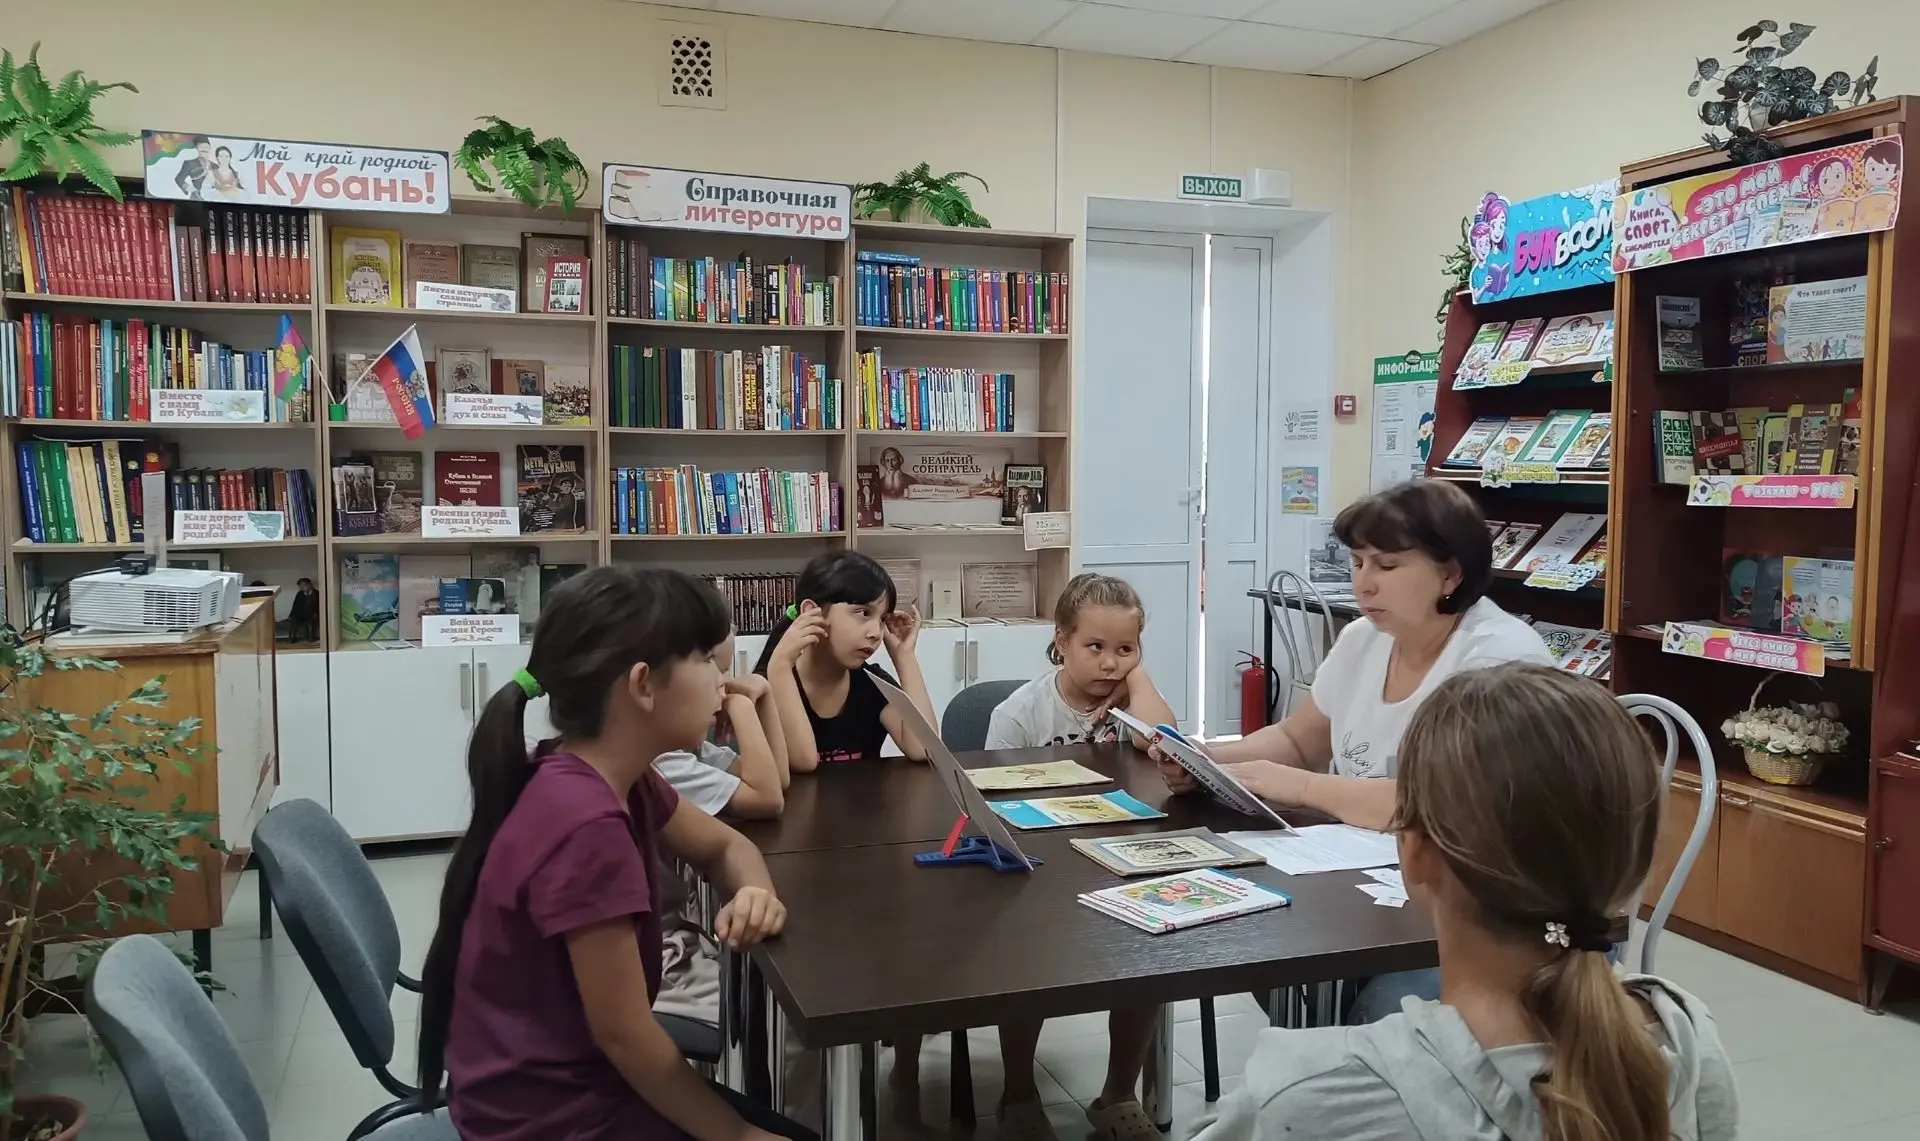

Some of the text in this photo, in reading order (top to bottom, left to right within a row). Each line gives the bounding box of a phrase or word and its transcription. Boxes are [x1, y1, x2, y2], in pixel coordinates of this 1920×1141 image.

[239, 142, 292, 162] Мой
[304, 151, 353, 169] край
[256, 161, 435, 205] Кубань!
[1184, 178, 1240, 196] ВЫХОД
[686, 178, 837, 208] Справочная
[685, 204, 842, 235] литература
[554, 262, 581, 272] ИСТОРИЯ
[1737, 353, 1767, 367] СПОР
[1377, 359, 1437, 376] ИНФОРМАЦ
[159, 392, 203, 400] Вместе
[392, 377, 414, 416] РОССИЯ
[921, 455, 973, 464] ВЕЛИКИЙ
[912, 465, 981, 474] СОБИРАТЕЛЬ
[183, 513, 243, 525] Как дорог
[430, 508, 469, 517] Овеяна
[432, 517, 512, 527] родная Кубань
[450, 617, 480, 626] Война
